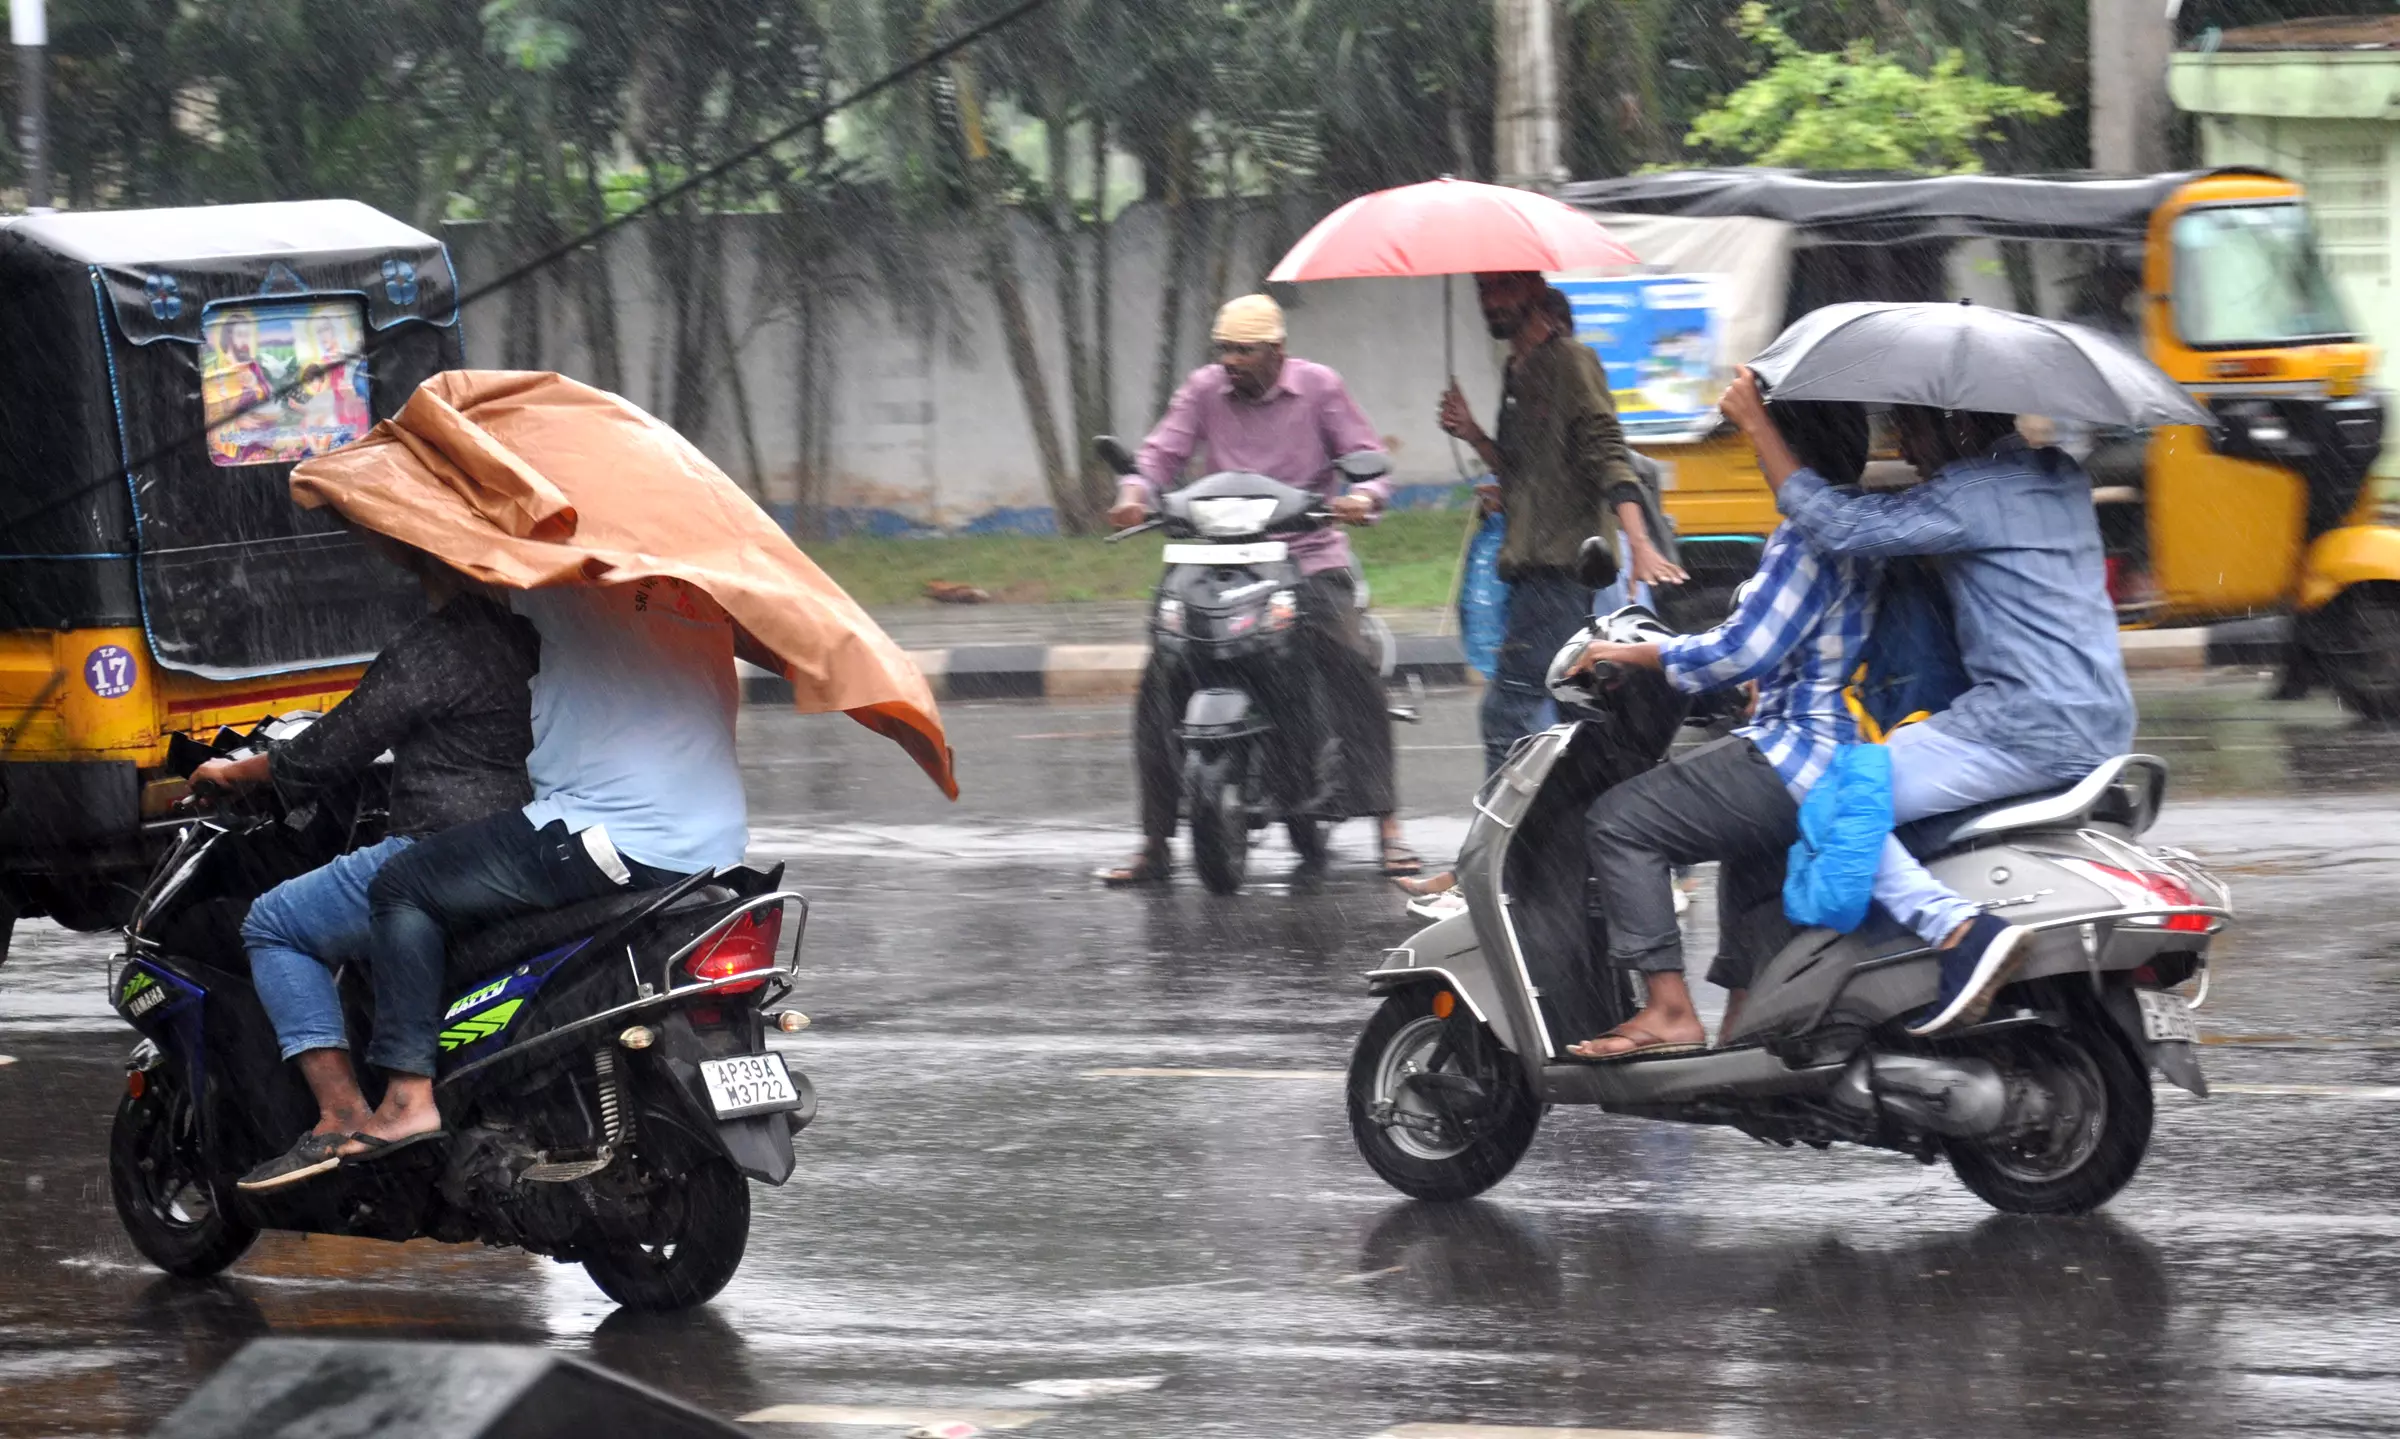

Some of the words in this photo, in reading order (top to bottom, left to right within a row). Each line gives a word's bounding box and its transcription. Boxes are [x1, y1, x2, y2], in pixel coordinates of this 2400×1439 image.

[91, 655, 127, 690] 17
[128, 985, 166, 1018] YAMAHA
[444, 983, 506, 1021] RALLY
[718, 1058, 776, 1085] AP39A
[725, 1079, 788, 1107] M3722
